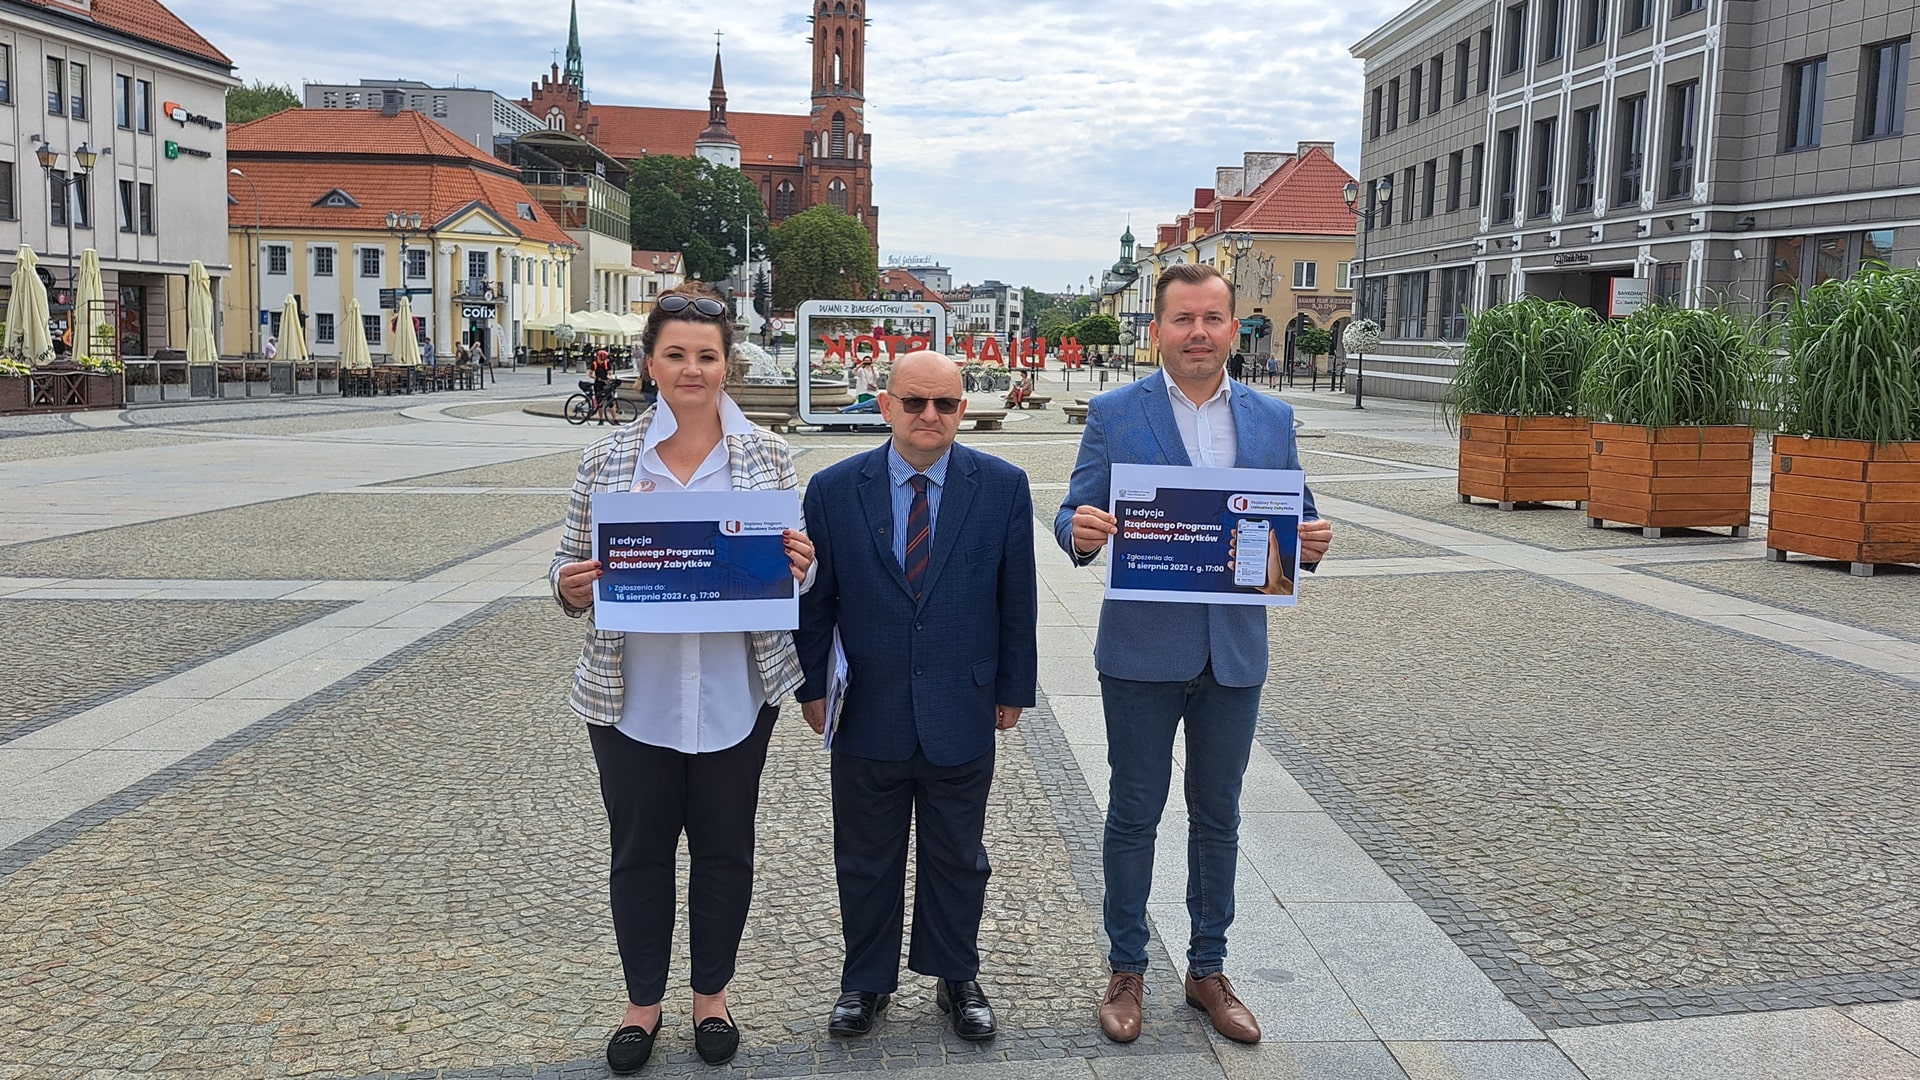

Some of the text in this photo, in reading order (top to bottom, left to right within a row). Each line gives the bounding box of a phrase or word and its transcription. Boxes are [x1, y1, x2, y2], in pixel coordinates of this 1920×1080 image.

[462, 306, 496, 318] cofix
[818, 304, 841, 312] DUMNI
[1125, 508, 1164, 519] II edycja
[1124, 520, 1222, 532] Rządowego Programu
[609, 536, 652, 547] II edycja
[1123, 532, 1218, 543] Odbudowy Zabytków
[609, 548, 714, 558] Rządowego Programu
[609, 559, 712, 570] Odbudowy Zabytków
[1137, 562, 1169, 572] sierpnia
[626, 593, 660, 602] sierpnia
